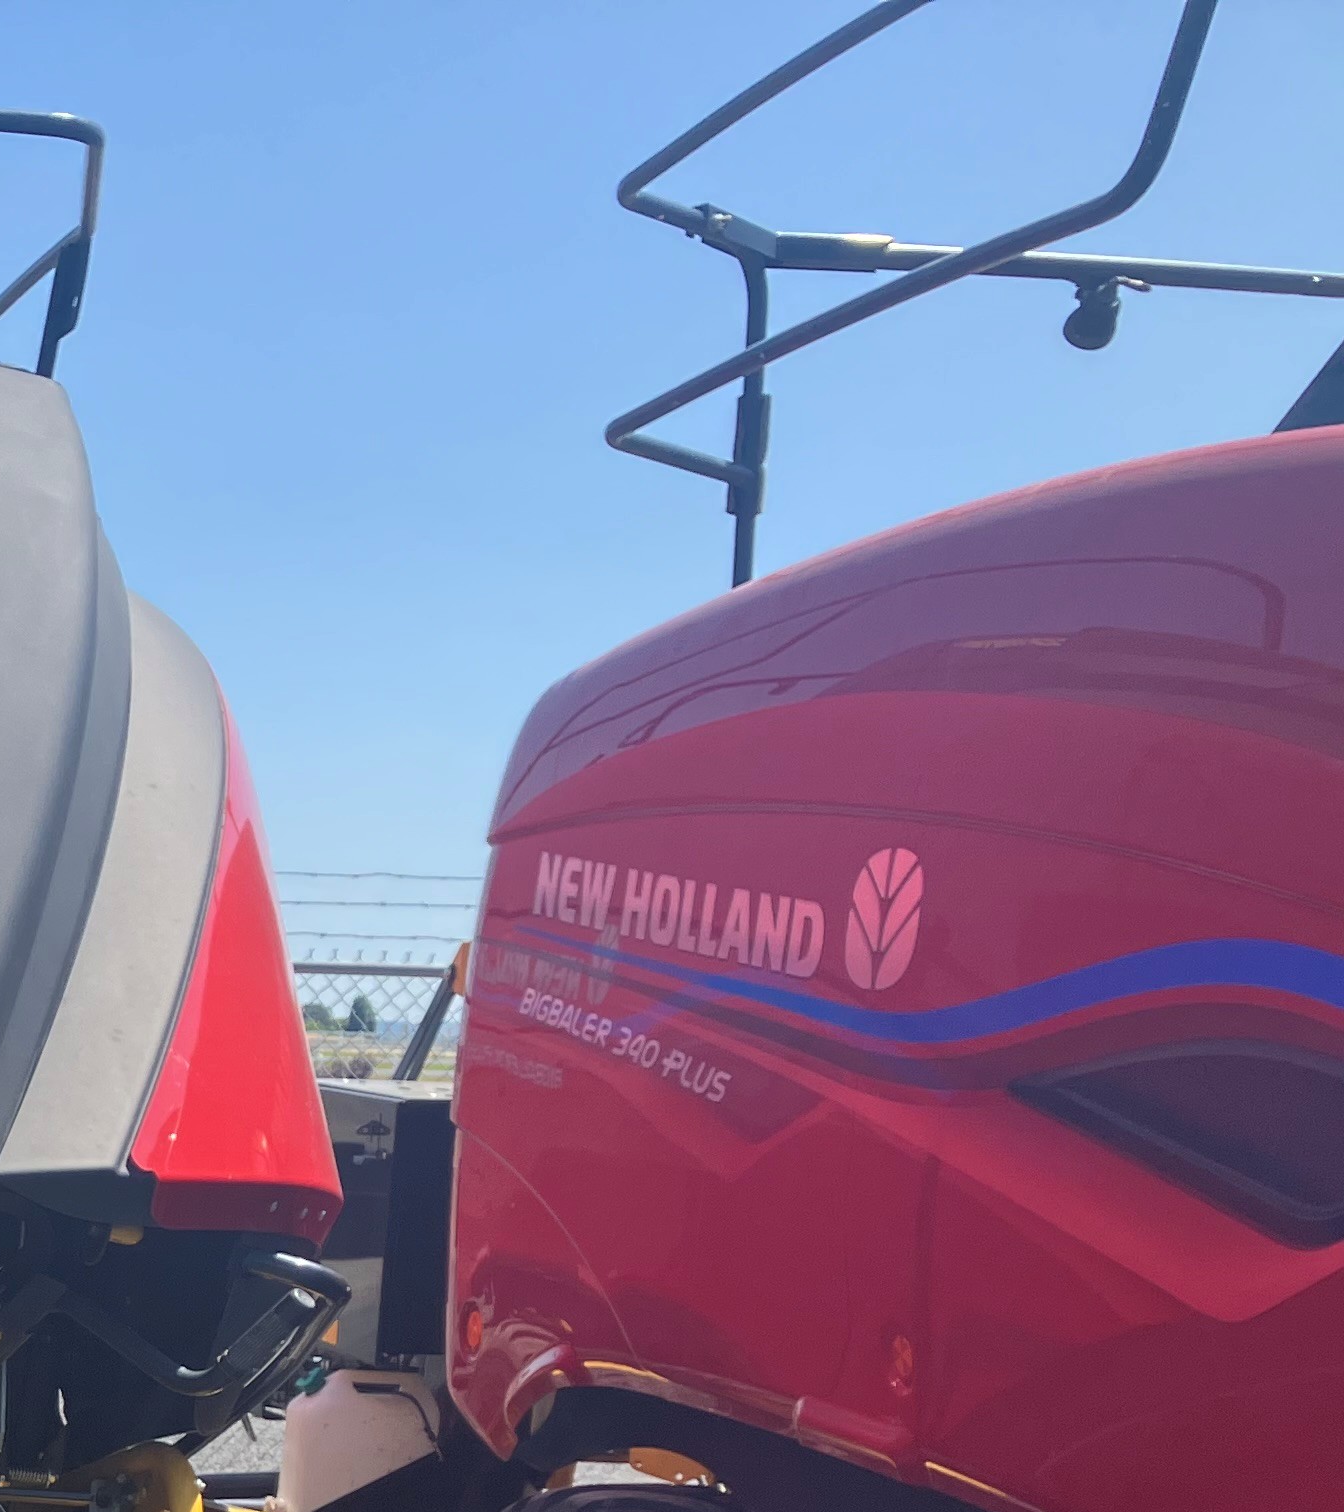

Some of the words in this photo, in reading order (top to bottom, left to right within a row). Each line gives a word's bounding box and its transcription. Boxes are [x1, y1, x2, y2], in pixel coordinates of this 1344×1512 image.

[532, 851, 617, 931] NEW
[620, 868, 825, 978] HOLLAND
[519, 987, 612, 1048] BIGBALER
[611, 1027, 660, 1069] 340
[662, 1048, 732, 1102] PLUS
